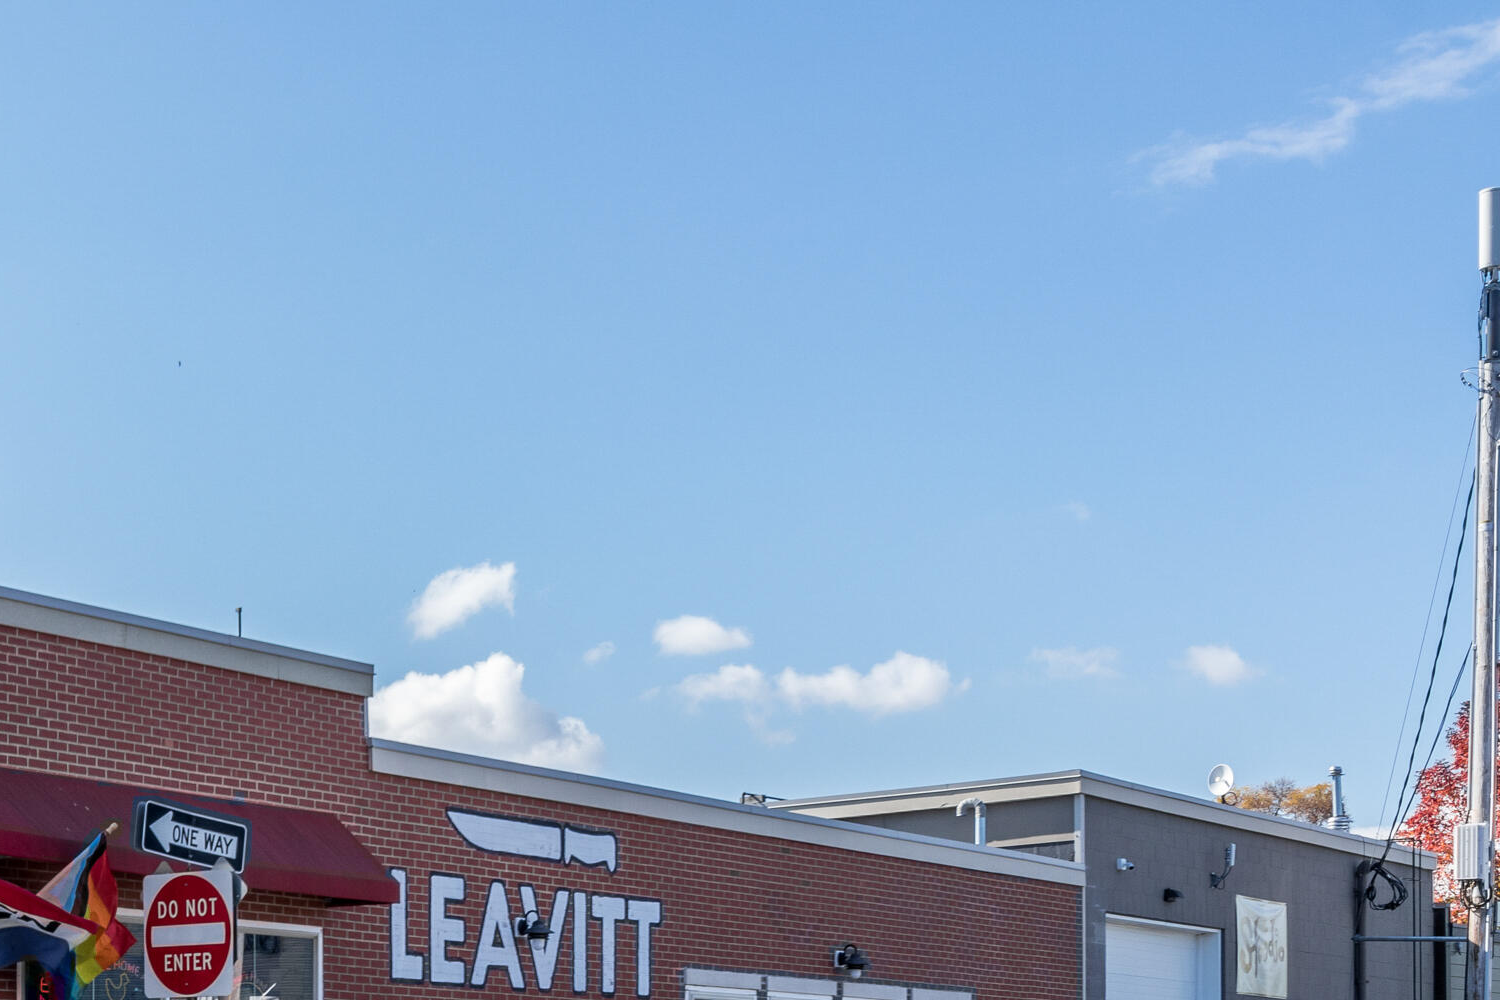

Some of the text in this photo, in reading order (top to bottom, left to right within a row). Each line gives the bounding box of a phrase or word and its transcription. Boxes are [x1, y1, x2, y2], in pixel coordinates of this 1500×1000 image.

[172, 824, 233, 855] ONE WAY
[157, 897, 218, 919] DO NOT
[389, 868, 662, 997] LEAVITT
[164, 951, 213, 972] ENTER
